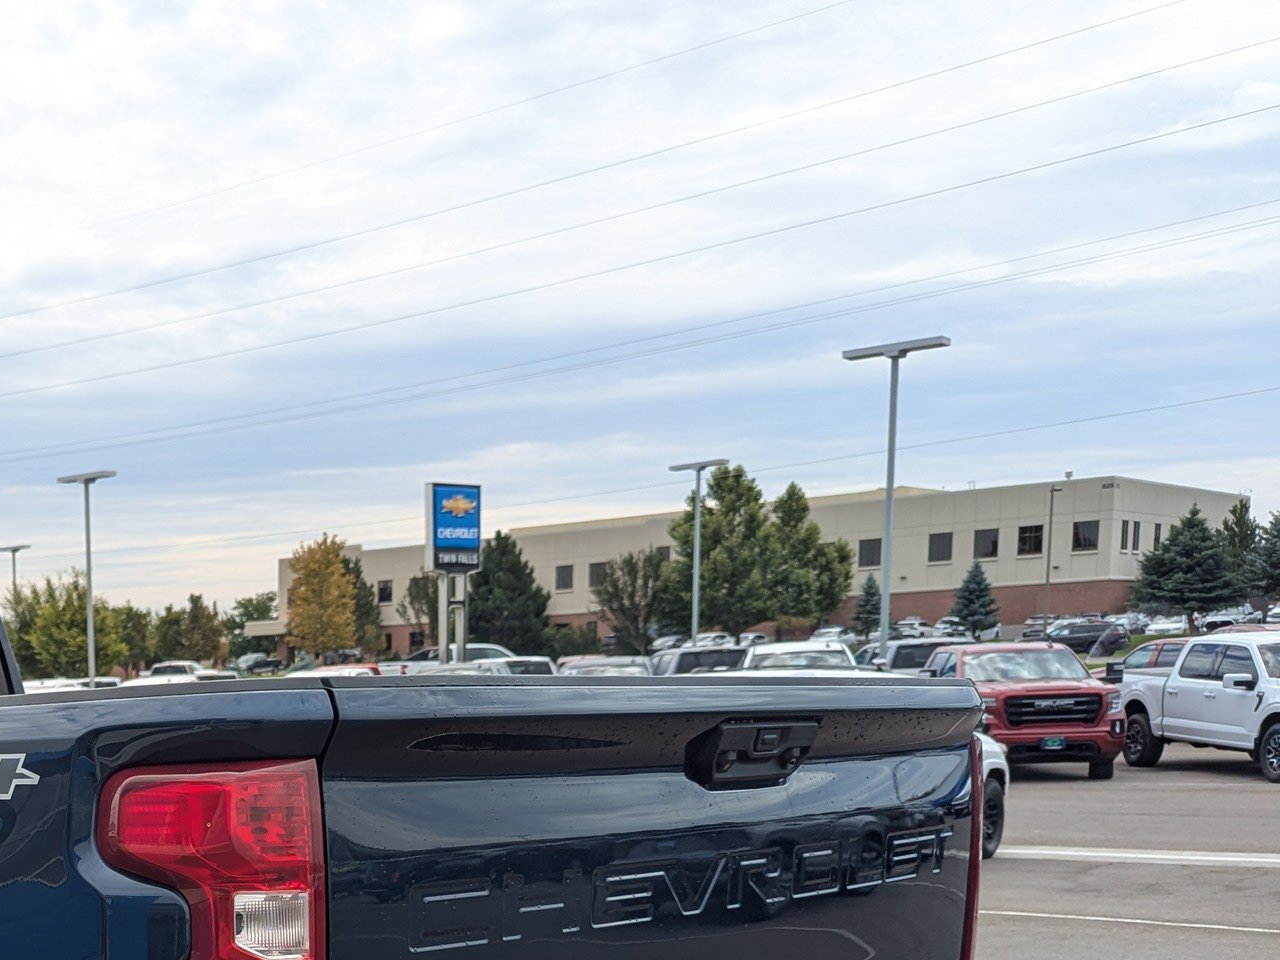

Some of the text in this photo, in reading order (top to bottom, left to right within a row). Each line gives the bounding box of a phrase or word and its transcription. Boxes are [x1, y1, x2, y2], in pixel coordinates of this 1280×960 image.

[437, 527, 479, 539] CHEVROLET
[439, 553, 478, 565] TWIN FALLS
